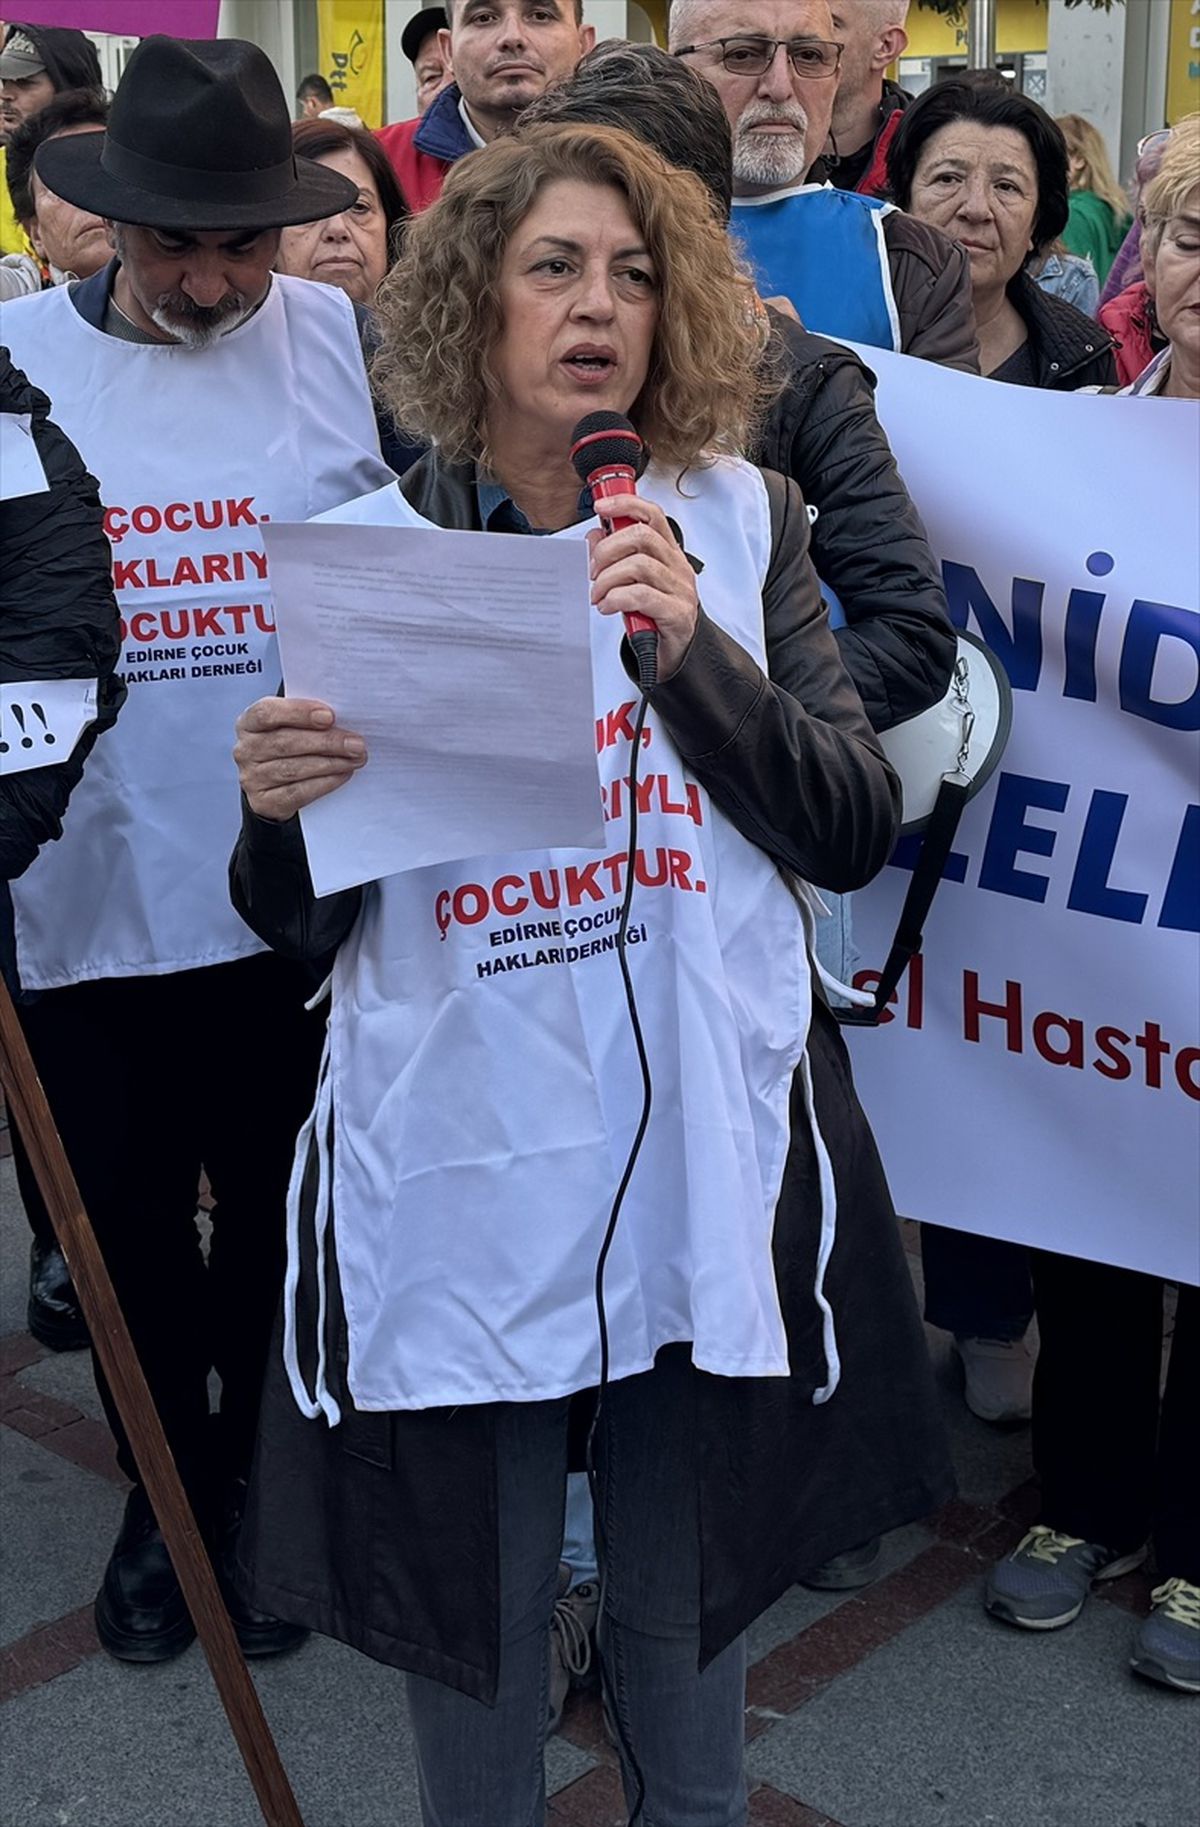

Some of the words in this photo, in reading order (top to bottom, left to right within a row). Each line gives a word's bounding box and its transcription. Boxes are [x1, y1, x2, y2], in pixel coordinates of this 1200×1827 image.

[126, 648, 186, 664] EDİRNE
[191, 643, 249, 661] ÇOCUK
[191, 659, 262, 679] DERNEĞİ
[435, 847, 707, 942] ÇOCUKTUR.
[489, 921, 562, 947] EDİRNE
[476, 948, 565, 979] HAKLARI
